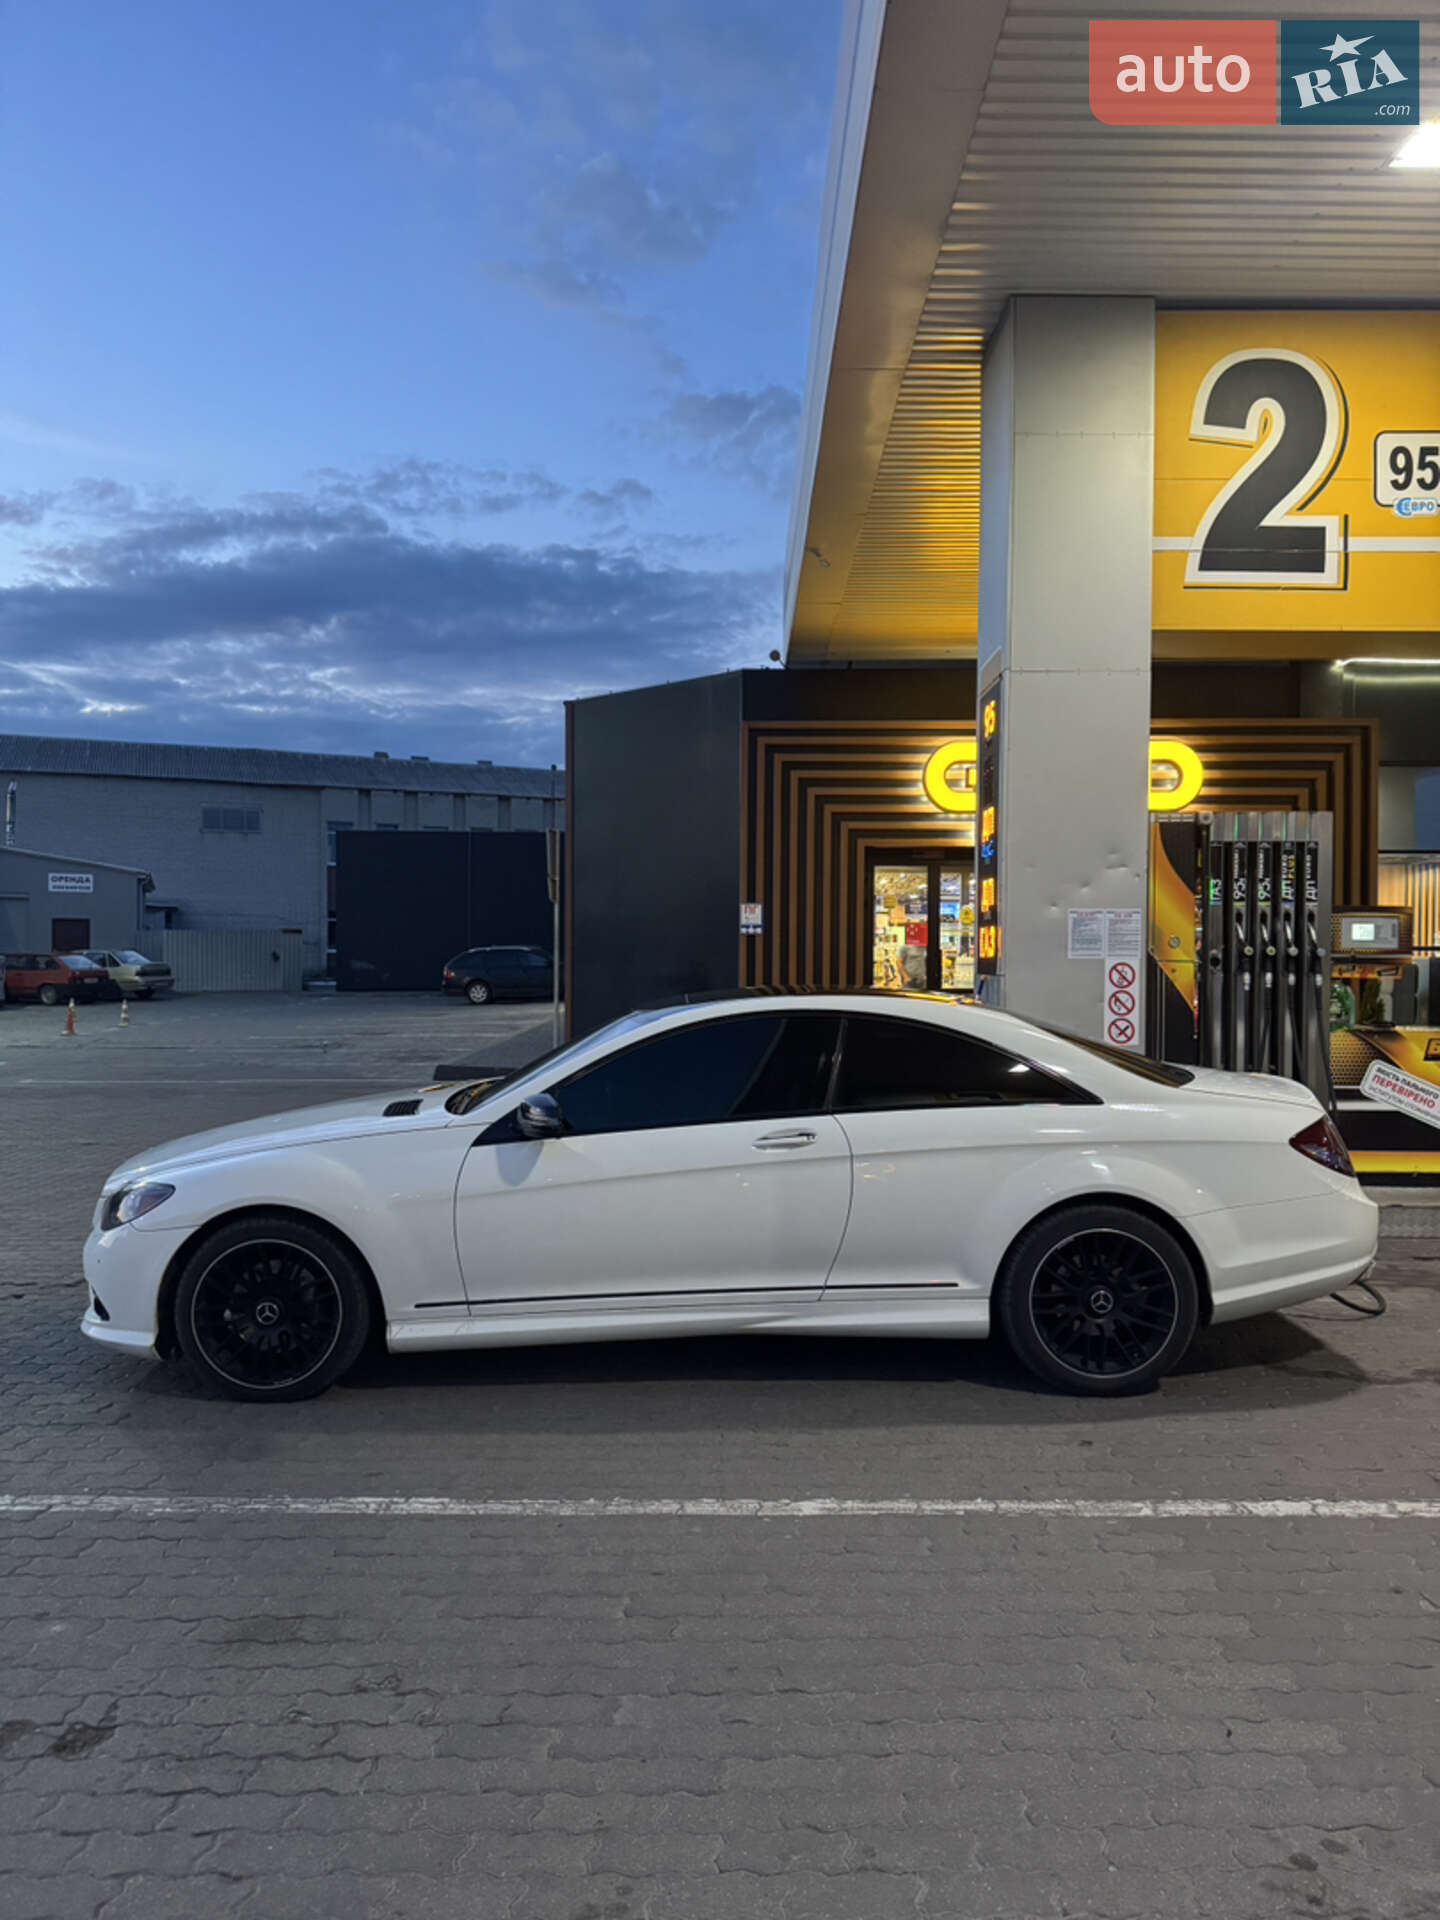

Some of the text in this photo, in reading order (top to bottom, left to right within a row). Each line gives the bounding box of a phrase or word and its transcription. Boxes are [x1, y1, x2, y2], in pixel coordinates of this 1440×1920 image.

[1184, 348, 1344, 587] 2
[1389, 445, 1440, 491] 95
[51, 875, 91, 884] ОРЕНДА
[1372, 1073, 1436, 1109] ПЕРЕВІРЕНО
